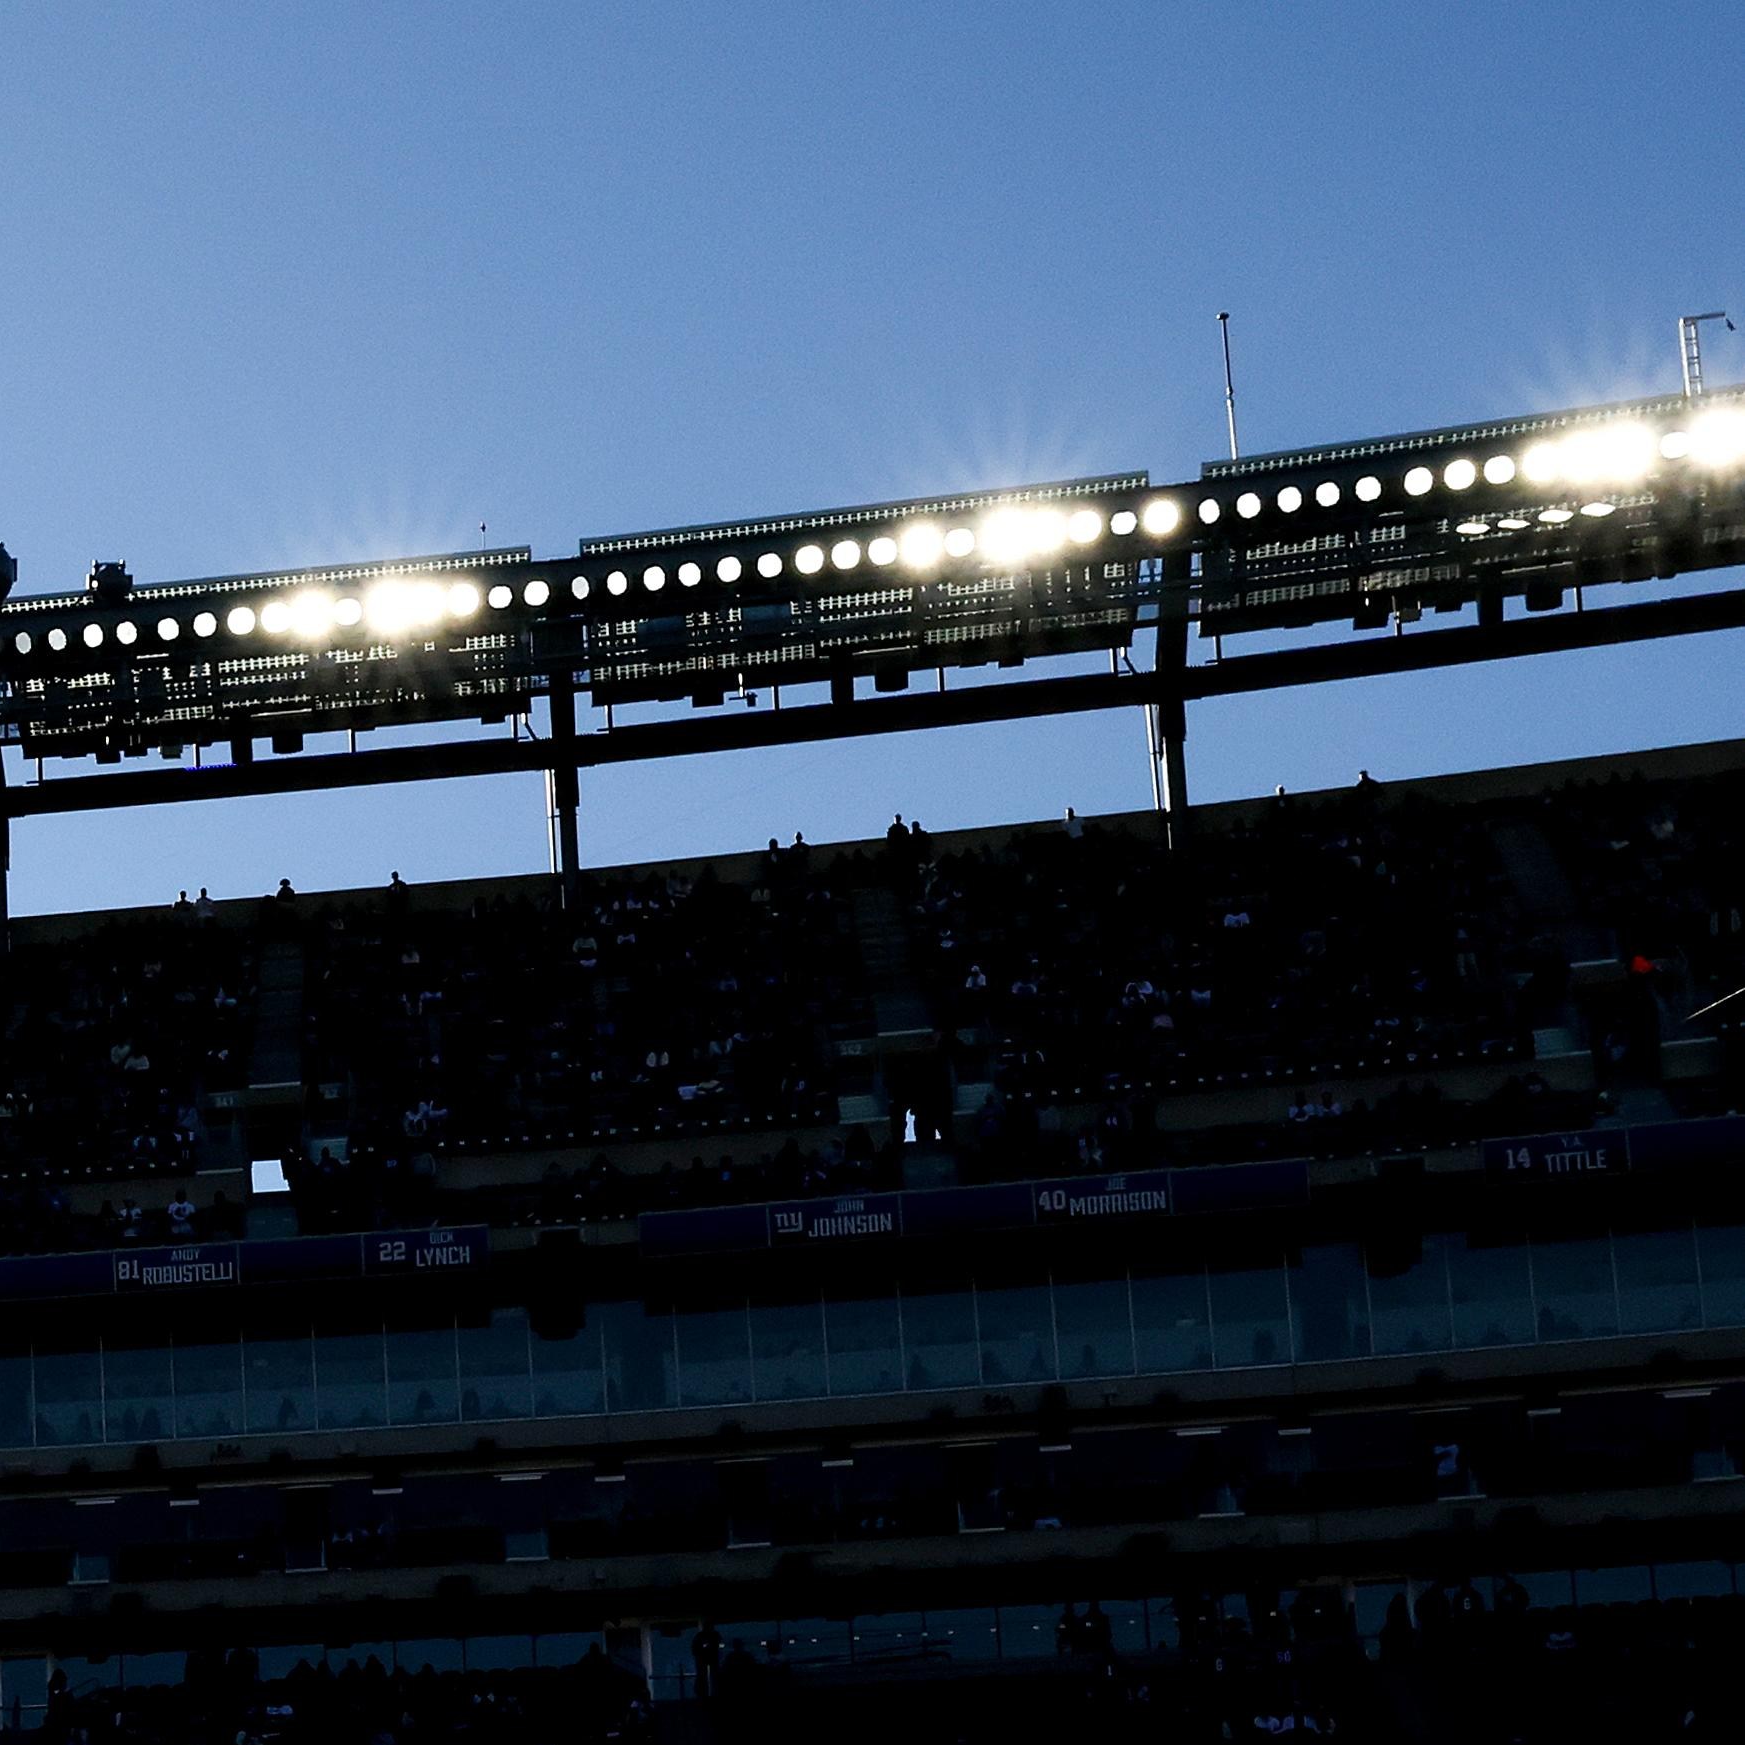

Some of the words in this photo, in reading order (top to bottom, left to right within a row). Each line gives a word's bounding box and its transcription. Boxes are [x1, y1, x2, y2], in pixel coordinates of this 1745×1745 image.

[1505, 1147, 1531, 1170] 14
[1543, 1149, 1608, 1174] TITTLE
[1038, 1190, 1067, 1213] 40
[1069, 1190, 1167, 1217] MORRISON
[807, 1213, 893, 1238] JOHNSON
[378, 1241, 407, 1262] 22
[415, 1245, 471, 1268] LYNCH
[142, 1261, 234, 1286] ROBUSTELLI
